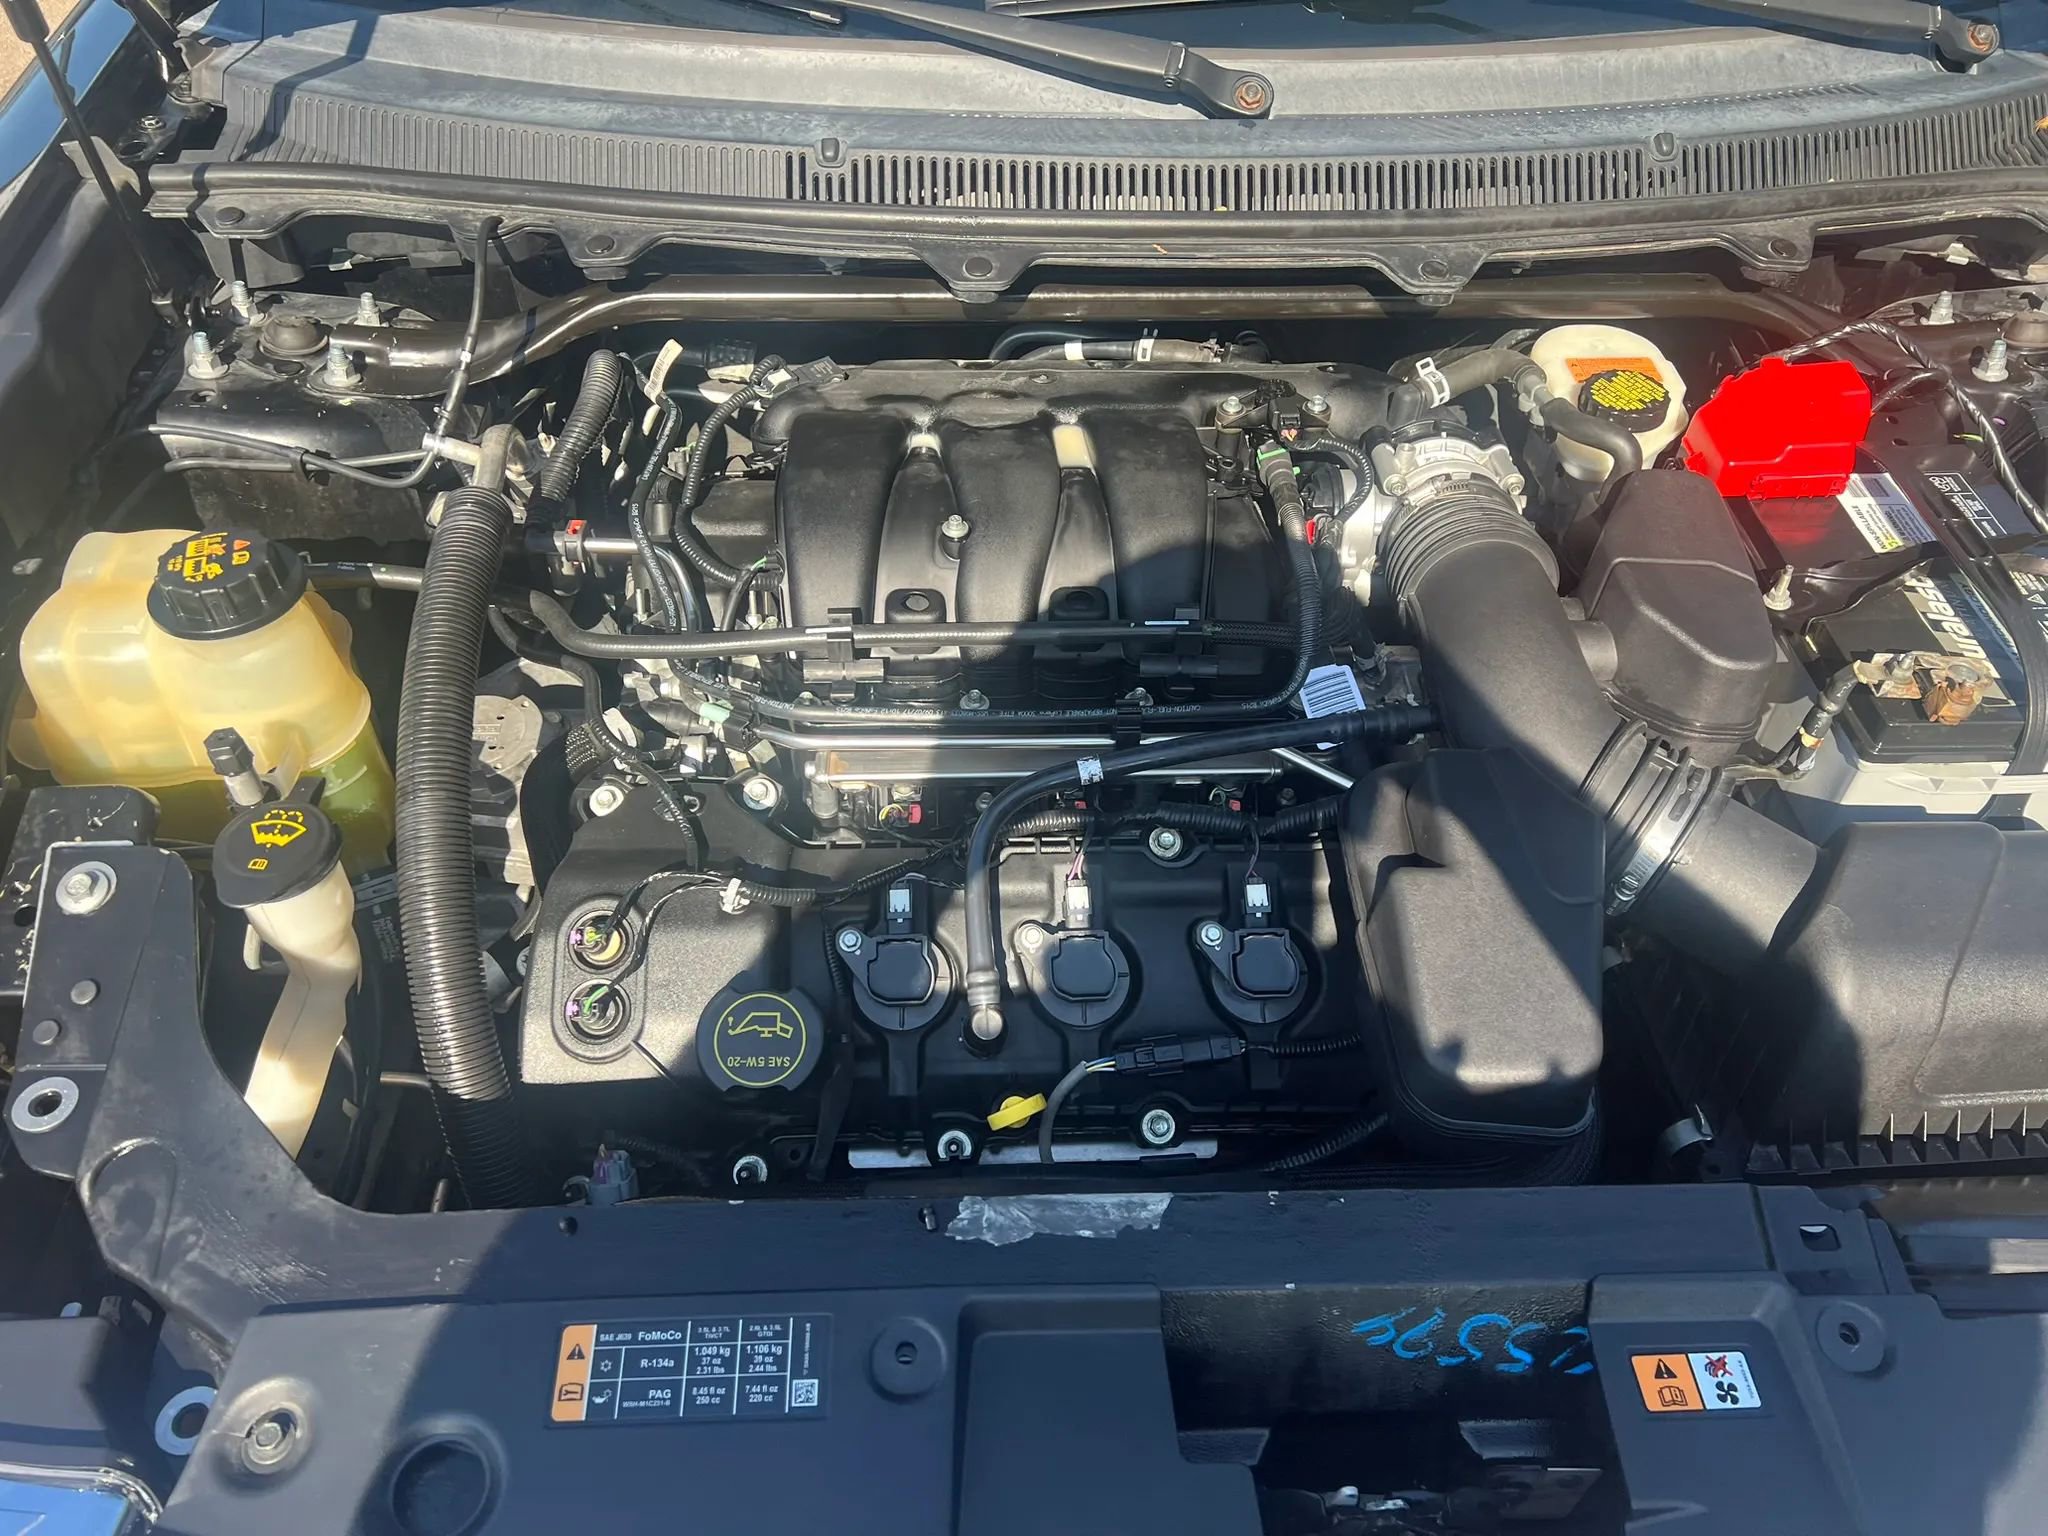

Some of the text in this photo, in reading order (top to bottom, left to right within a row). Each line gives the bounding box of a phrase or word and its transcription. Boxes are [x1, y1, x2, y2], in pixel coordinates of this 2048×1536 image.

[1904, 576, 2001, 679] uralast
[727, 1056, 791, 1067] SAE 5W-20
[599, 1332, 615, 1342] SAE
[638, 1330, 683, 1341] FoMoCo
[694, 1346, 731, 1357] 1.049 kg
[746, 1344, 783, 1355] 1.106 kg
[640, 1357, 675, 1368] R-134a
[701, 1357, 711, 1365] 37
[696, 1366, 725, 1374] 2.31 lbs
[748, 1364, 778, 1373] 2.44 lbs
[648, 1388, 672, 1399] PAG
[692, 1386, 726, 1395] 8.45 fl oz
[745, 1384, 779, 1393] 7.44 fl oz
[696, 1396, 721, 1405] 250 cc
[748, 1394, 774, 1403] 220 cc
